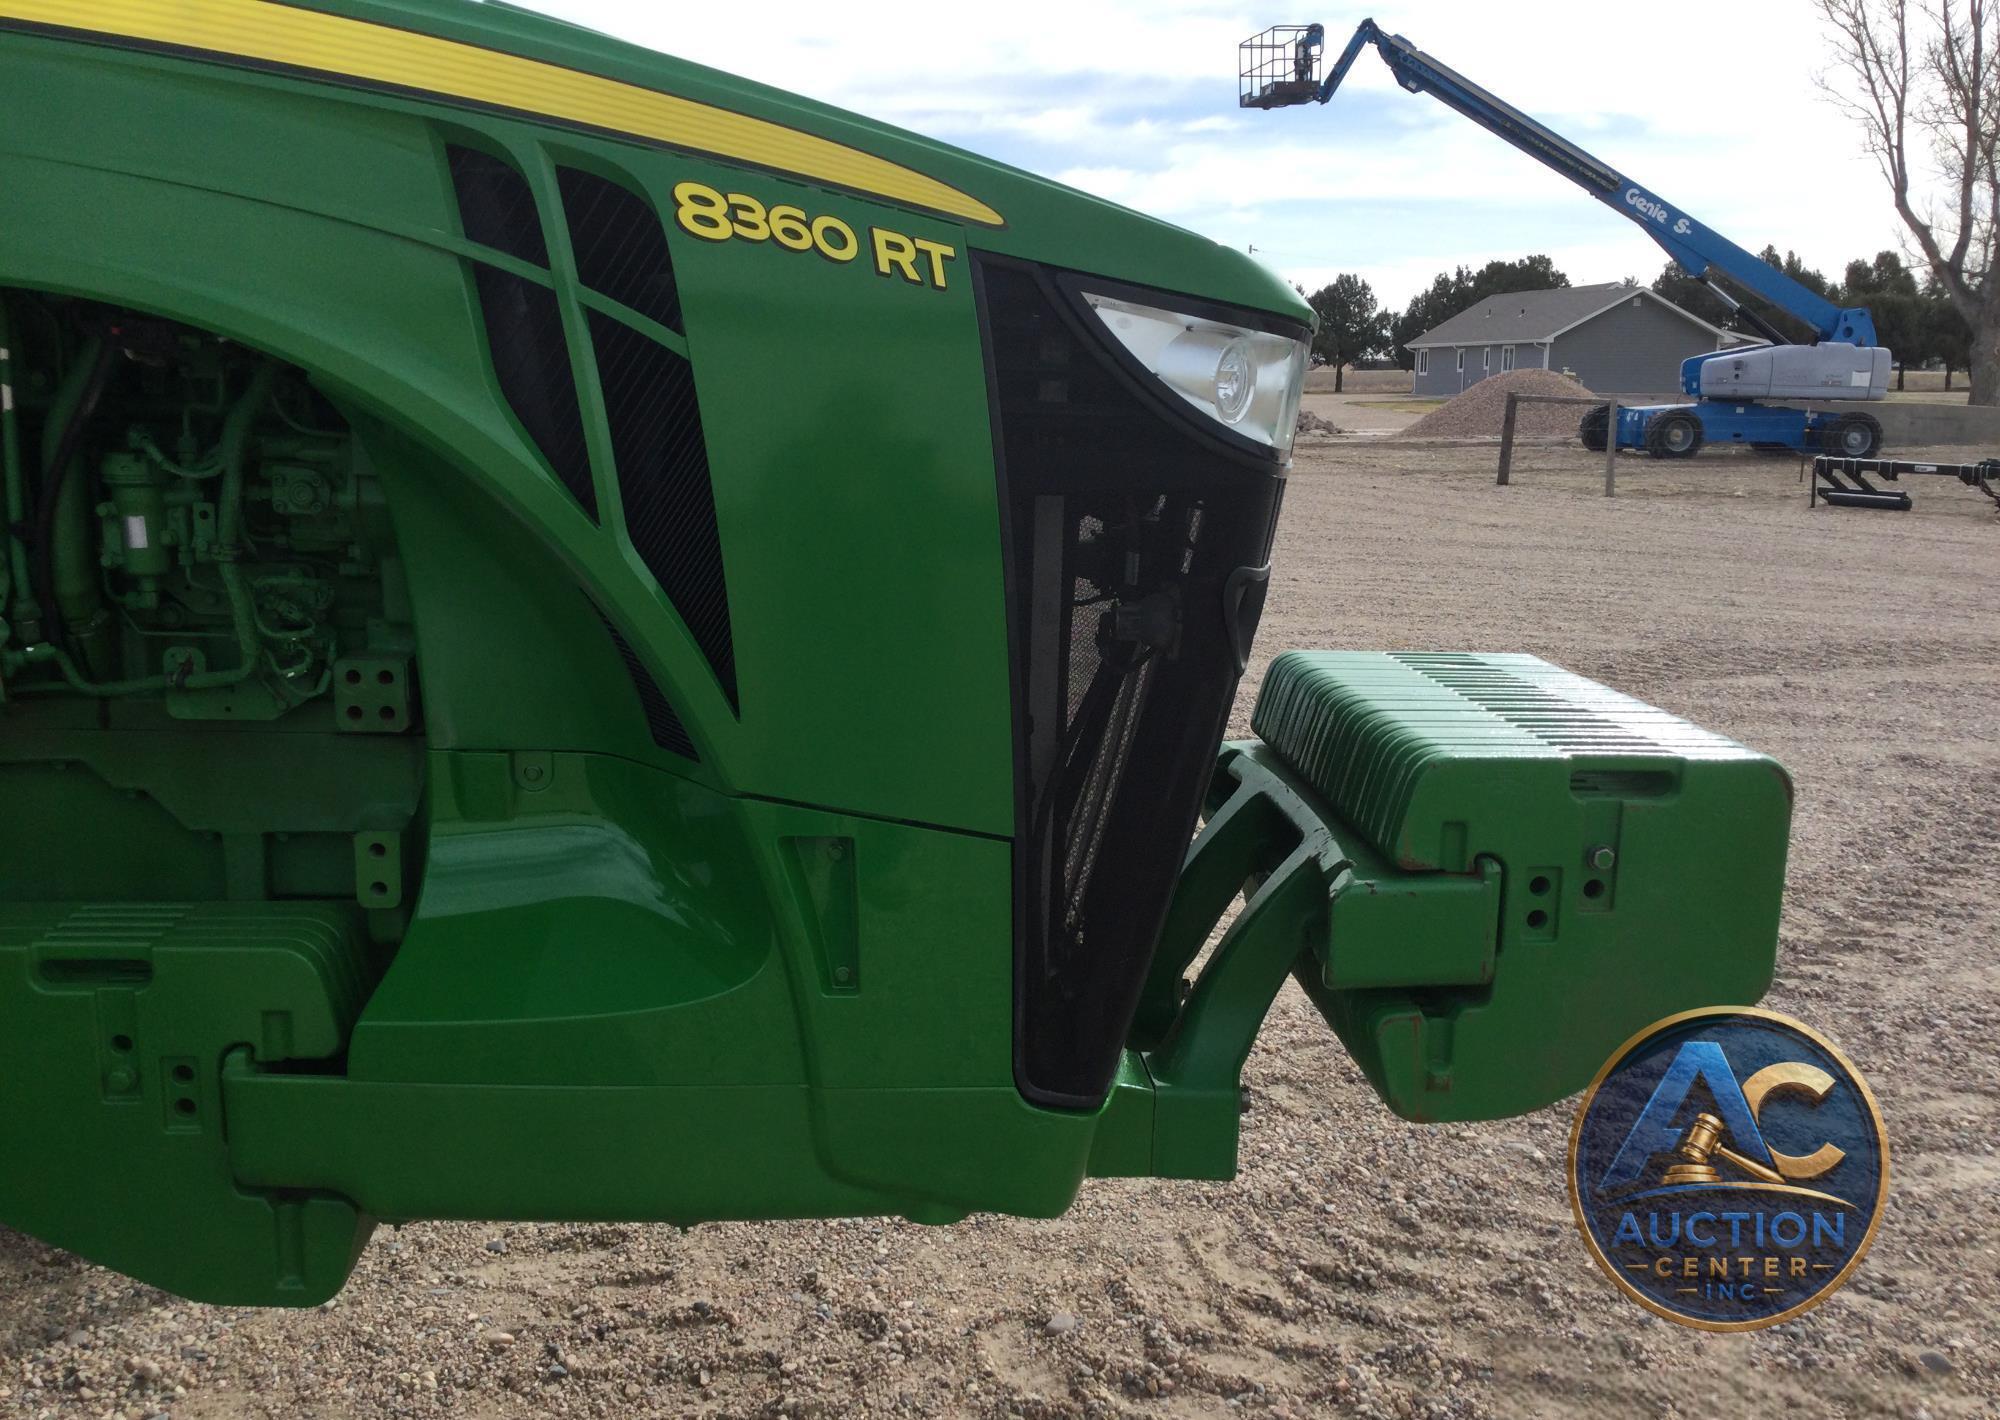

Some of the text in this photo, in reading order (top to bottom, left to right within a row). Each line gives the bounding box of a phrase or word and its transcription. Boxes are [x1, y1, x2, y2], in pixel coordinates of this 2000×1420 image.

[673, 181, 956, 290] 8360 RT
[1625, 188, 1668, 224] Genie
